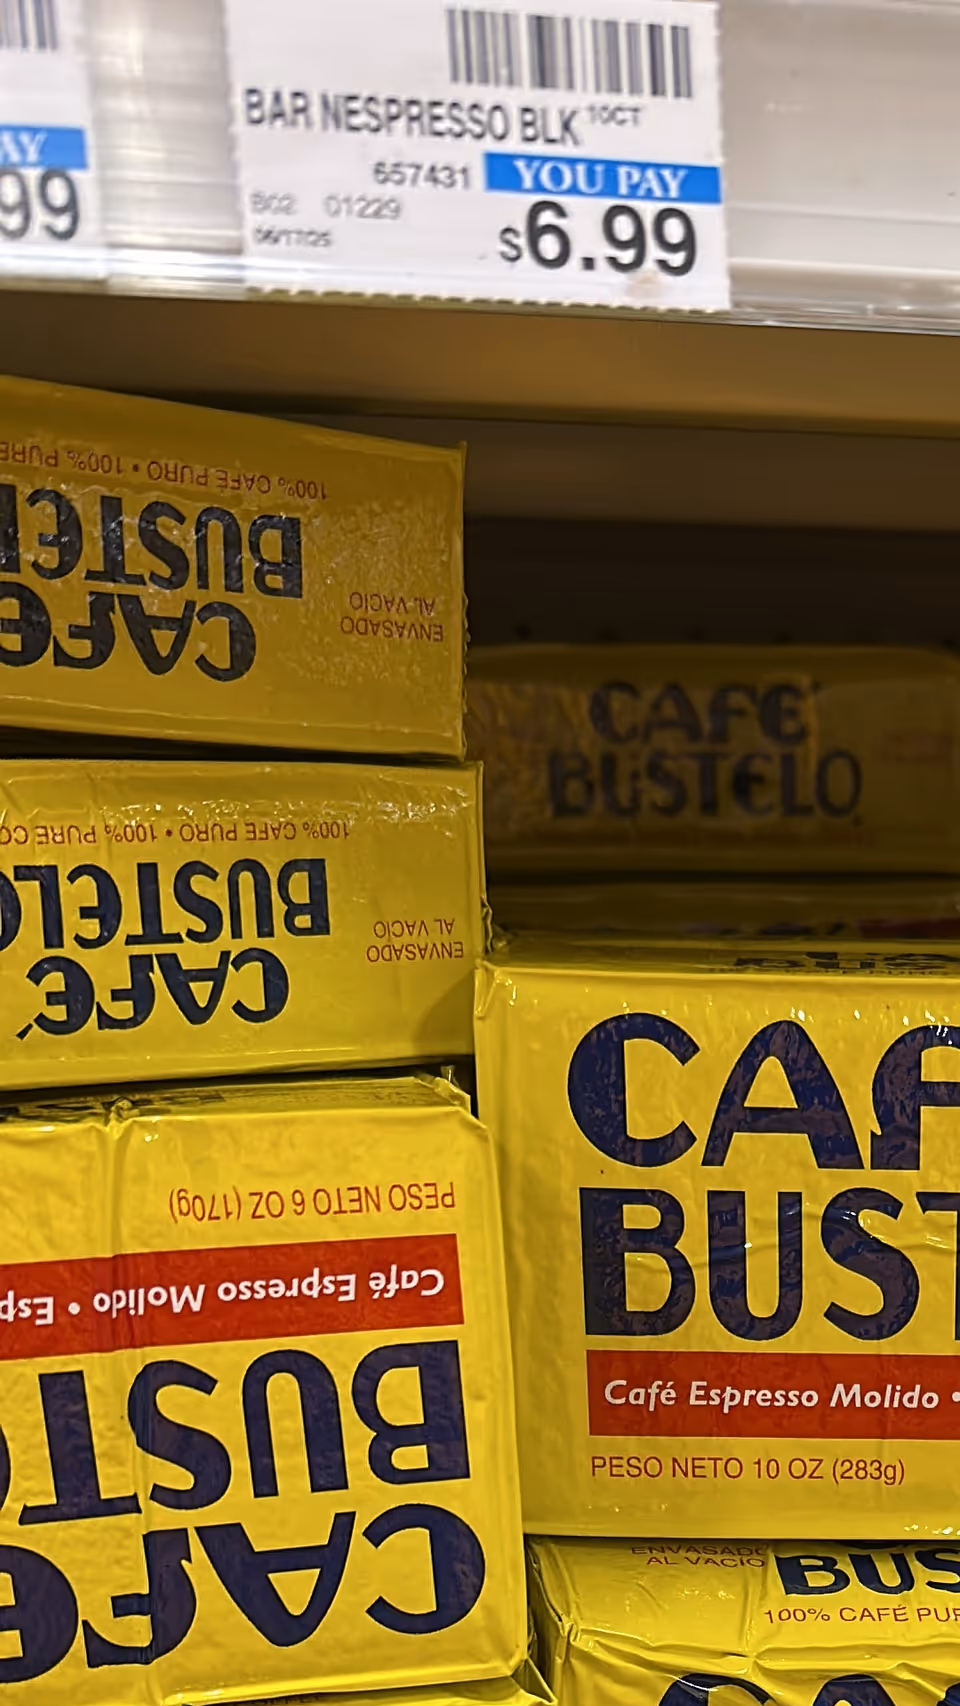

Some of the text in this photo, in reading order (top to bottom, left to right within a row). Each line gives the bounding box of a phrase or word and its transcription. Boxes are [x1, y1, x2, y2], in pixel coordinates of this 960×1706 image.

[245, 88, 313, 128] BAR
[321, 95, 509, 142] NESPRESSO
[520, 107, 581, 146] BLK
[373, 159, 688, 199] 657431 YOU PAY
[499, 199, 699, 277] $6.99
[66, 450, 123, 475] 100%
[147, 461, 209, 487] PURO
[278, 477, 328, 500] 100%
[340, 616, 444, 641] ENVASADO
[549, 750, 863, 819] BUSTELO
[36, 825, 97, 845] PURE
[104, 824, 157, 844] 100%
[179, 823, 238, 842] PURO
[303, 822, 351, 840] 100%
[366, 940, 464, 963] ENVASADO
[169, 1181, 455, 1224] PESO NETO 6 OZ (170g)
[0, 1264, 446, 1326] Café Espresso Molido Esp
[604, 1379, 677, 1412] Café
[689, 1381, 819, 1414] Espresso
[829, 1383, 940, 1410] Molido
[0, 1339, 470, 1526] BUST
[591, 1456, 906, 1486] PESO NETO 10 OZ (283g)
[764, 1607, 831, 1624] 100%
[839, 1602, 909, 1623] CAFÉ
